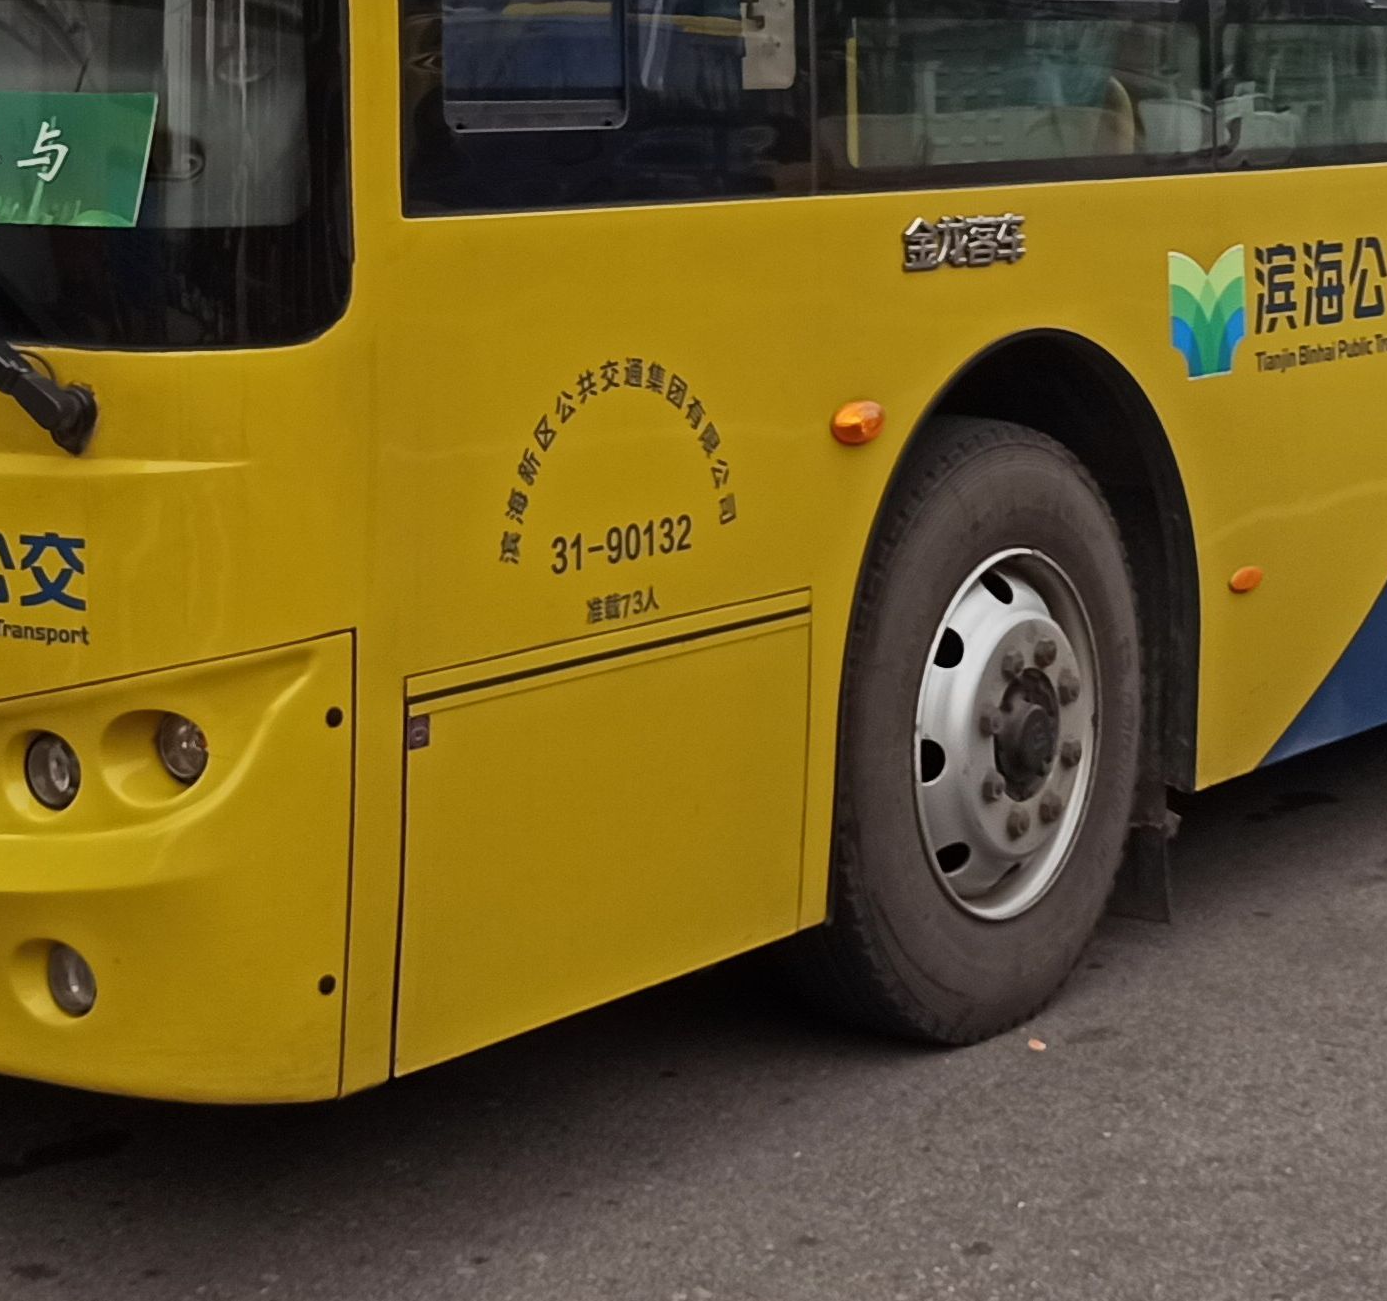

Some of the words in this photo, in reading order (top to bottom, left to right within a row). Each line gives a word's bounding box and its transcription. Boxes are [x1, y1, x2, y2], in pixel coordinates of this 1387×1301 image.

[902, 212, 1026, 271] 金龙客车
[550, 513, 693, 575] 31-90132
